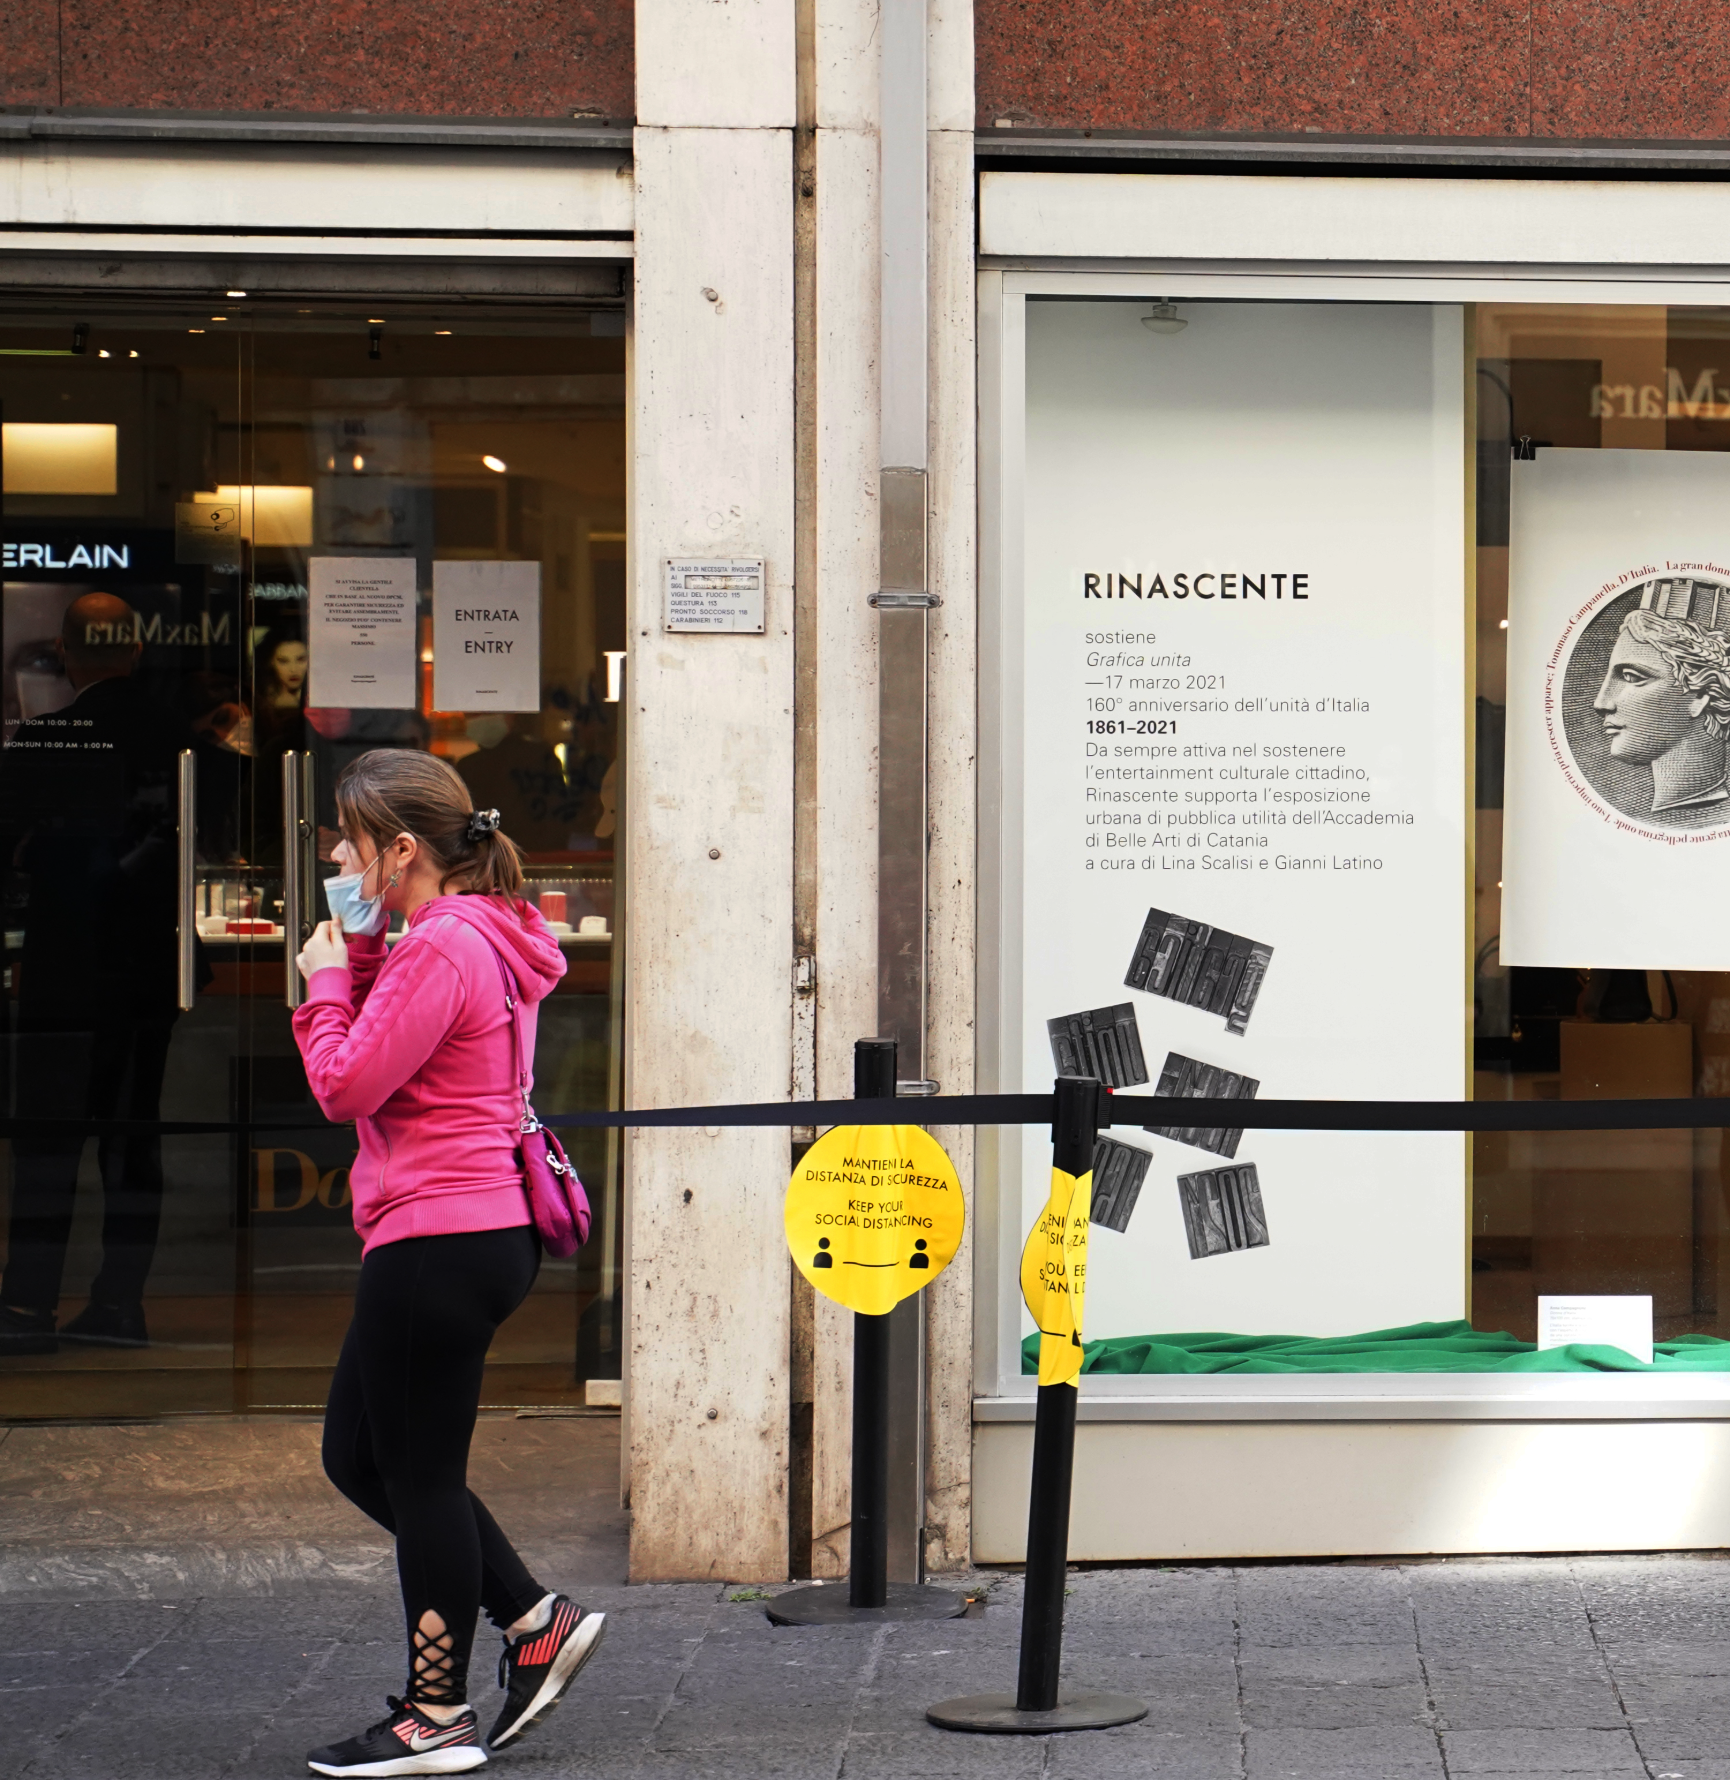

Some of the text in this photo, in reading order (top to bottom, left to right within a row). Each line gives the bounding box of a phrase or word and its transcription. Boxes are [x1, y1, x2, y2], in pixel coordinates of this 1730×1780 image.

[2, 543, 129, 569] ERLAIN
[1084, 572, 1309, 601] RINASCENTE
[705, 591, 728, 599] FUOCO
[731, 591, 741, 599] 115
[455, 609, 519, 622] ENTRATA
[699, 608, 736, 616] SOCCORSO
[1085, 629, 1156, 645] sostiene
[464, 640, 514, 654] ENTRY
[1086, 651, 1191, 667] Grafica unita
[1129, 678, 1181, 690] marzo
[1186, 674, 1225, 690] 2021
[1086, 697, 1370, 713] 160° anniversario dell'unità d'Italia
[4, 718, 20, 726] LUN
[73, 719, 93, 727] 20:00
[1086, 741, 1346, 761] Da sempre attiva nel sostenere
[1085, 764, 1370, 782] l'entertainment culturale cittadino,
[1086, 787, 1371, 806] Rinascente supporta l'esposizione
[1086, 809, 1414, 828] urbana di pubblica utilità dell'Accademia
[1085, 832, 1268, 848] di Belle Arti di Catania
[1085, 854, 1383, 870] a cura di Lina Scalisi e Gianni Latino
[842, 1156, 915, 1171] MANTIENI LA
[805, 1169, 949, 1192] DISTANZA DI SCUREZZA
[848, 1199, 904, 1213] KEEP YOUR
[815, 1213, 933, 1230] SOCIAL DISTANCING
